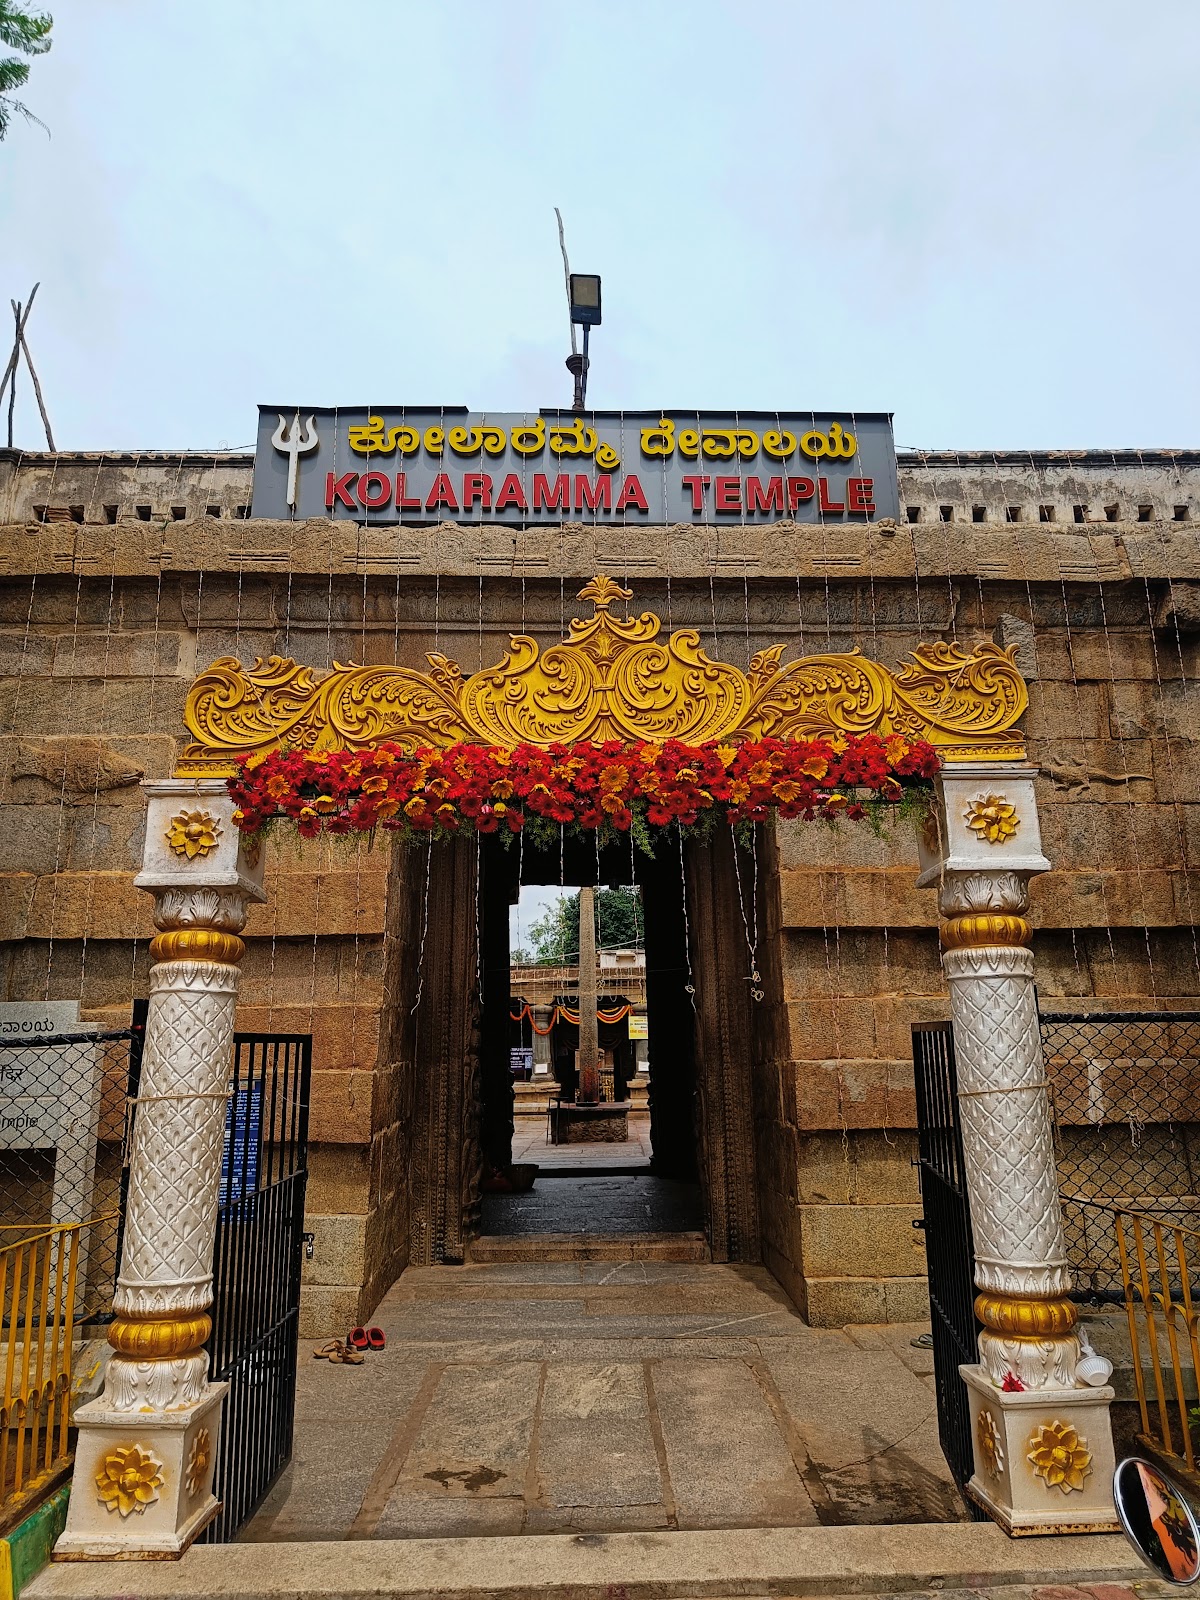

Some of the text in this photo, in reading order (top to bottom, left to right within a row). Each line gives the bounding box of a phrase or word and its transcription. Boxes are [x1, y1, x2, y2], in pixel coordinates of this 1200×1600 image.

[348, 415, 857, 470] ಕೋಲಾರಮ್ಮ ದೇವಾಲಯ
[325, 471, 877, 513] KOLARAMMA TEMPLE
[0, 1017, 54, 1033] ವಾಲಯ
[1, 1114, 38, 1131] mple
